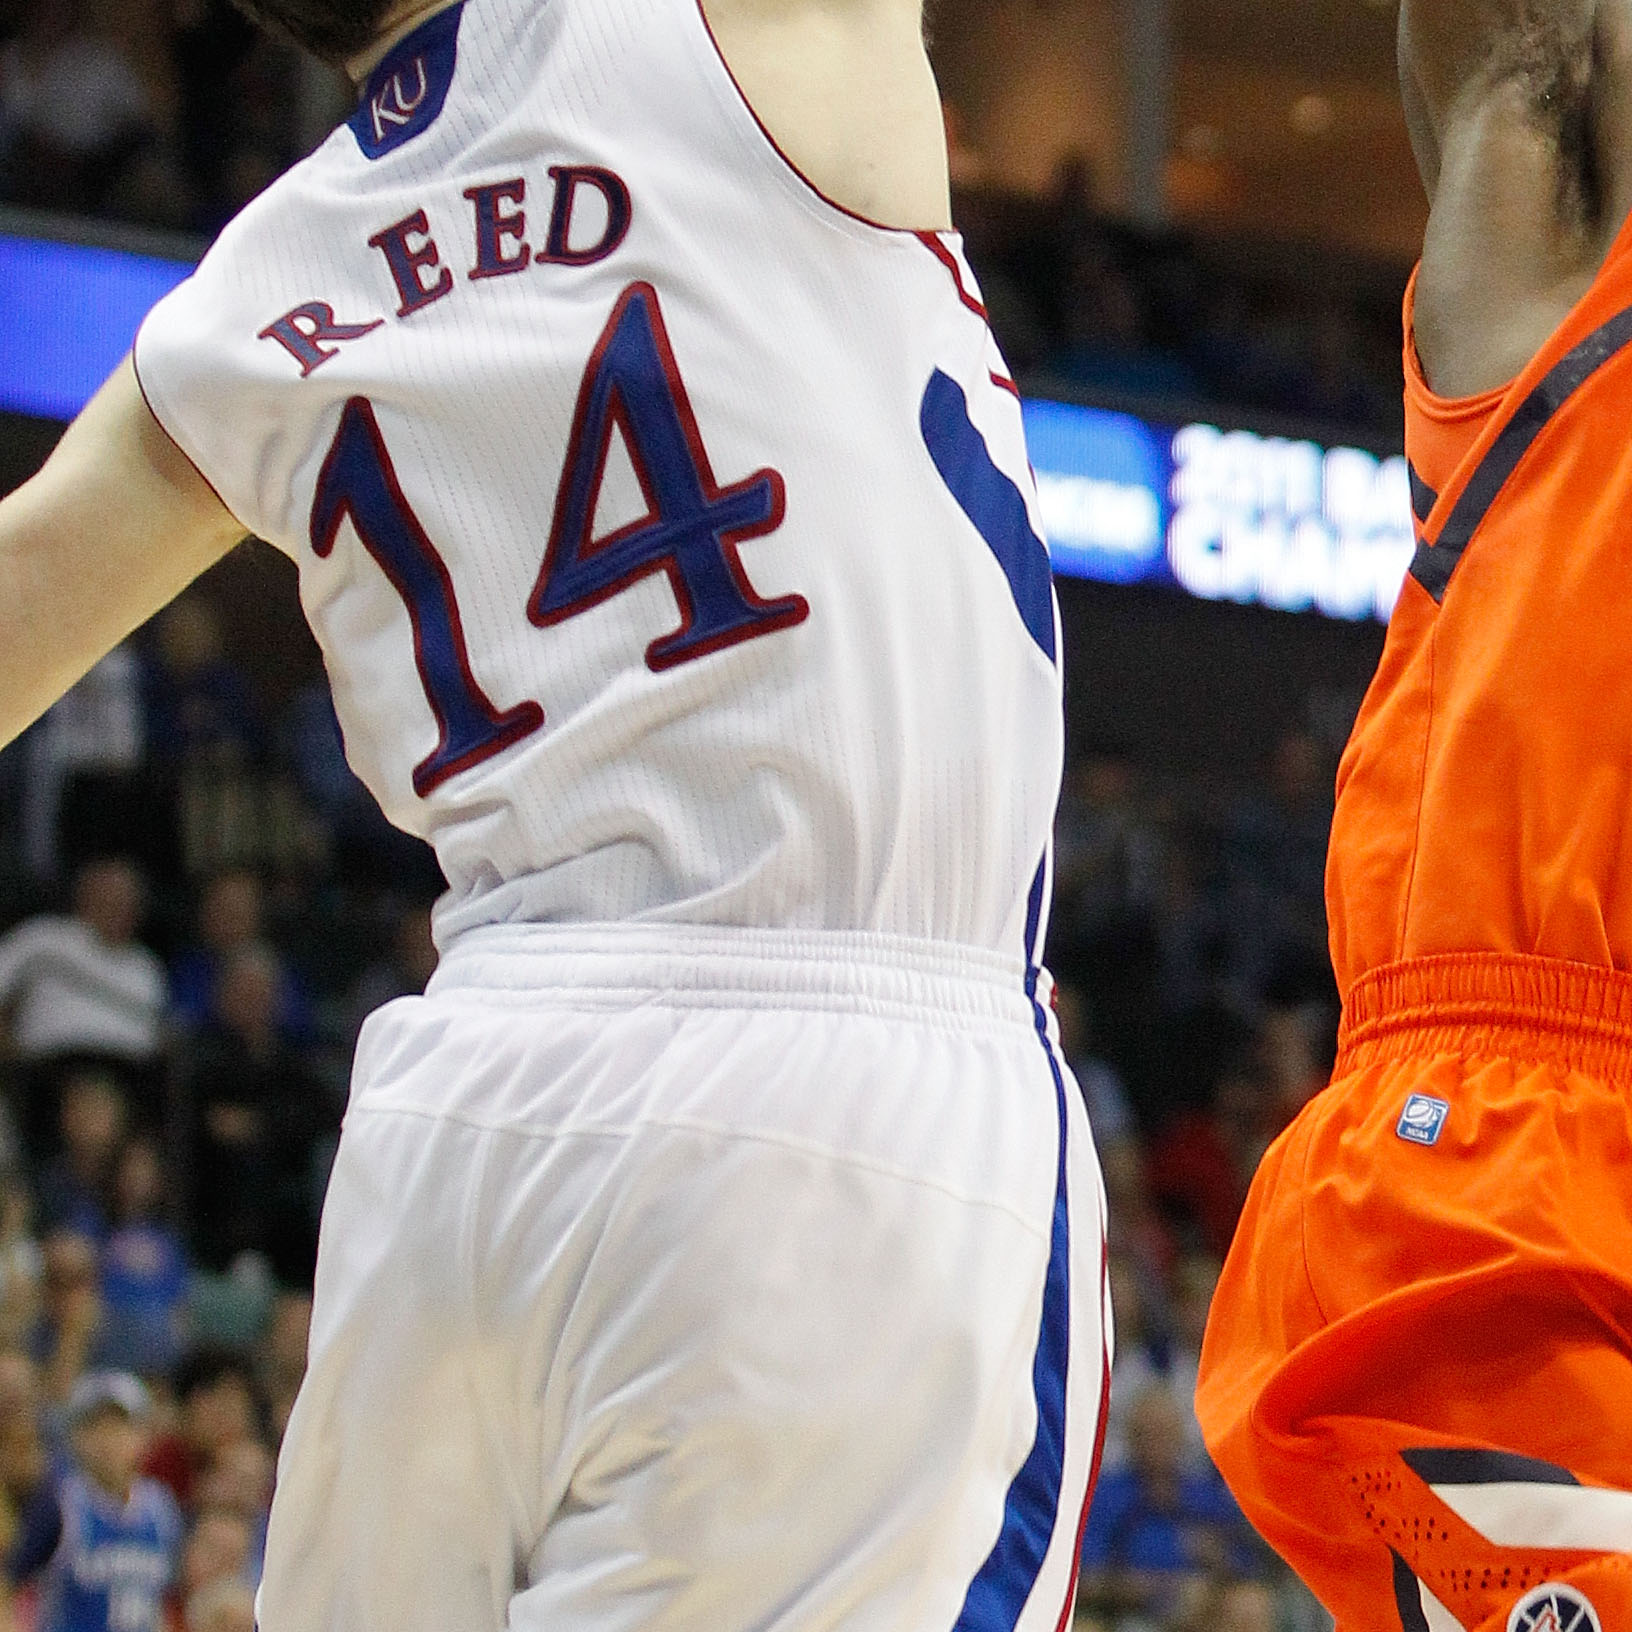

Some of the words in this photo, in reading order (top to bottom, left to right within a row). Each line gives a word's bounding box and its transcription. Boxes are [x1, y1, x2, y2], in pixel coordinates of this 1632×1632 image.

[371, 56, 427, 144] KU
[257, 164, 633, 378] REED
[309, 280, 810, 799] 14
